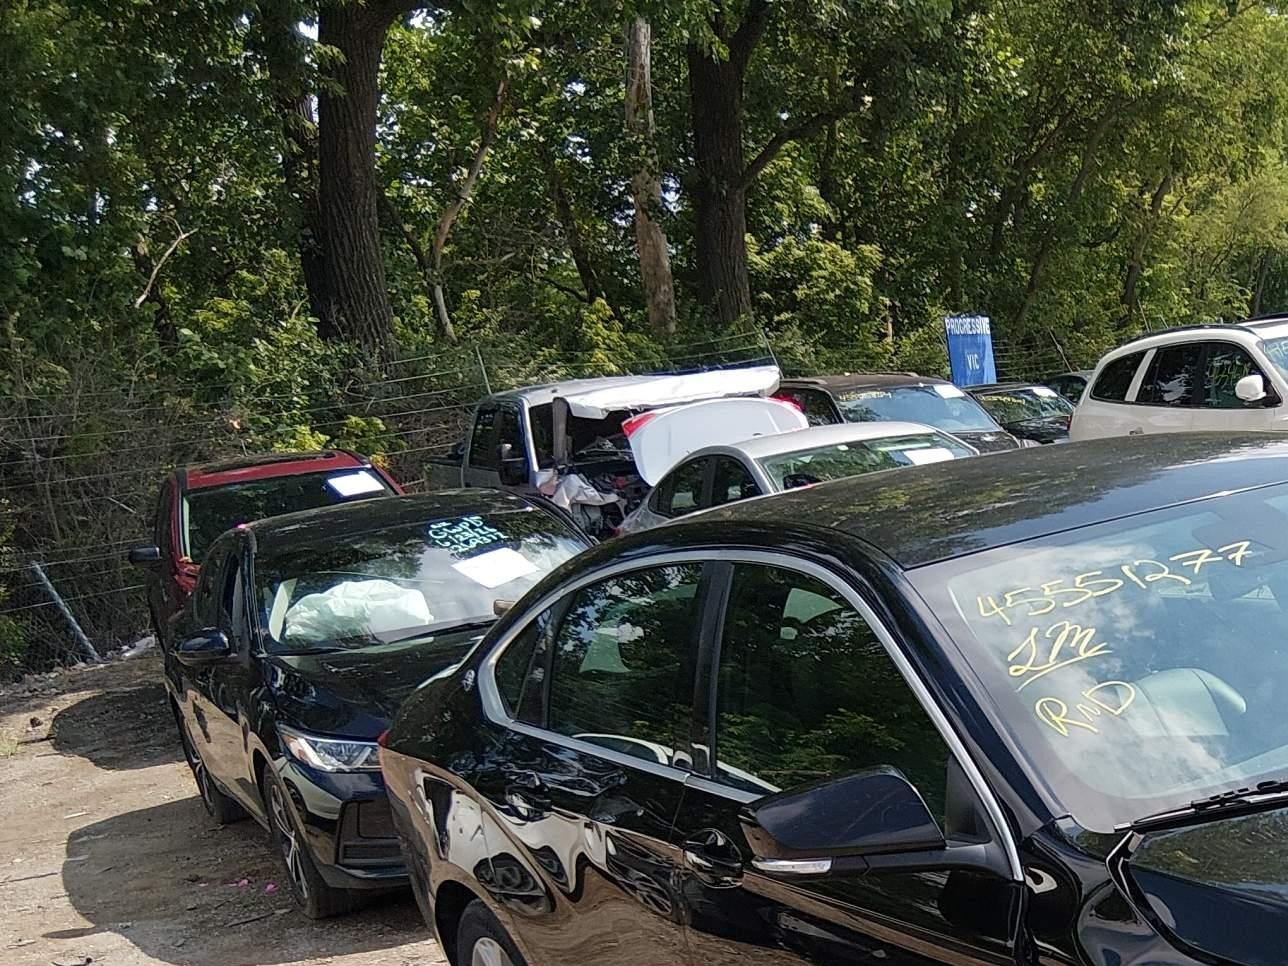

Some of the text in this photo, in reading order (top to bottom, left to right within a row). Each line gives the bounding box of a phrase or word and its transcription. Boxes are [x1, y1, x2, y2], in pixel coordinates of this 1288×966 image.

[944, 316, 991, 335] PROGRESSIVE
[966, 353, 980, 371] VIC
[976, 541, 1253, 626] 45551277
